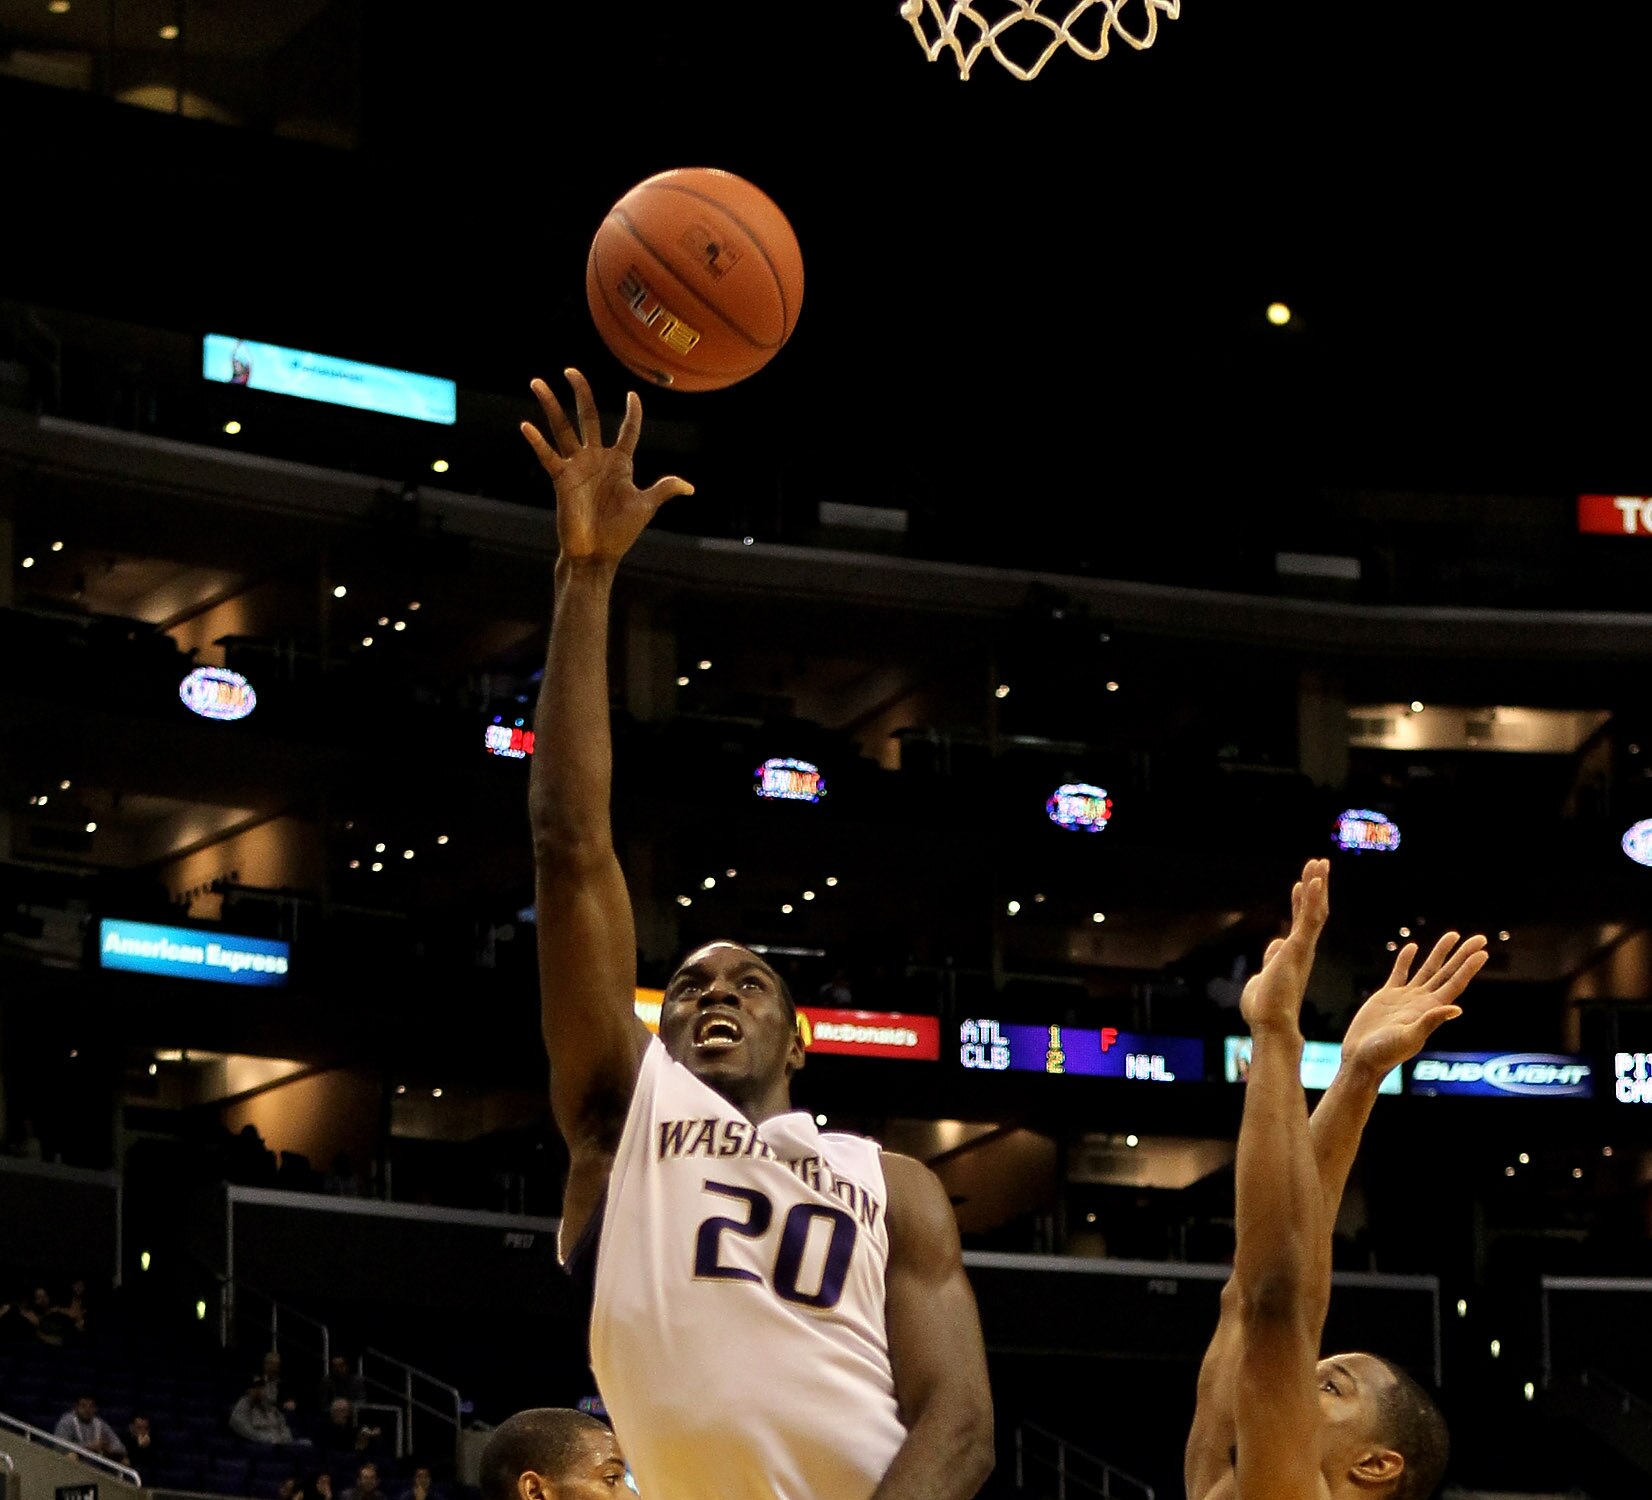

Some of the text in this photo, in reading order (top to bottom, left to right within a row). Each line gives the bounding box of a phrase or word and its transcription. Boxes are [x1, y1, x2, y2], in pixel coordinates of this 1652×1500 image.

[105, 931, 289, 974] American Express
[960, 1018, 1118, 1053] ATL 1 F
[960, 1042, 1066, 1074] CLB 2
[1125, 1053, 1175, 1082] NHL
[1412, 1060, 1484, 1082] BUD
[692, 1178, 858, 1314] 20
